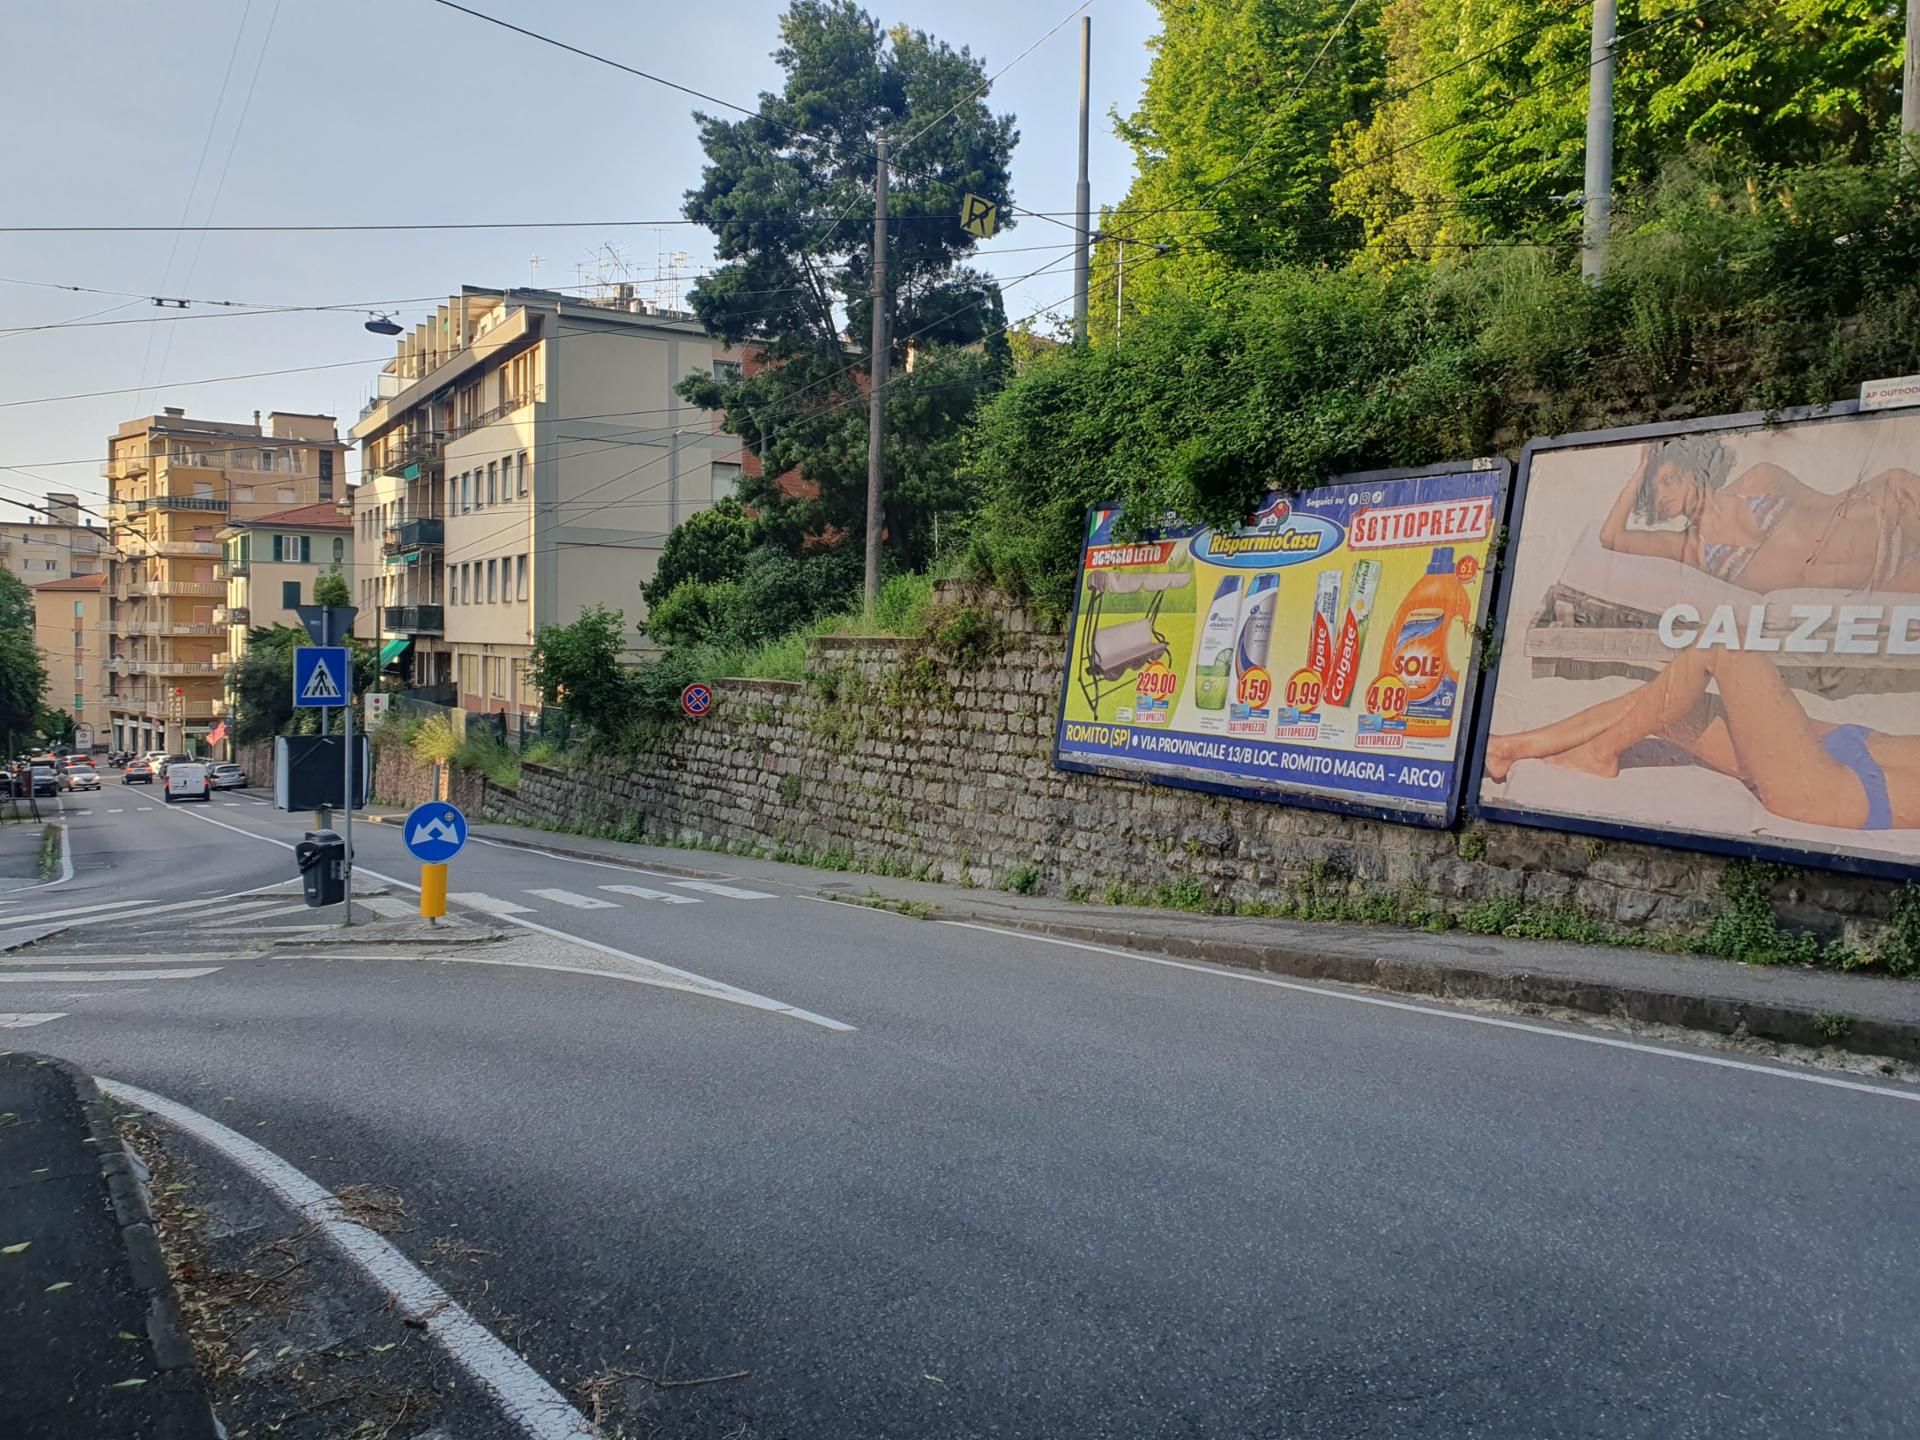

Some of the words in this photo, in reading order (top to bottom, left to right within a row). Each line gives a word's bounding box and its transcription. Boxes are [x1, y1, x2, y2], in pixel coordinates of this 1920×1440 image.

[1880, 386, 1920, 397] OUTDOO
[1306, 497, 1333, 509] Seguici
[1134, 545, 1162, 563] LETTO
[1209, 528, 1321, 556] RisparmioCasa
[1357, 561, 1371, 595] Herbal
[1460, 561, 1473, 575] 61
[1658, 603, 1920, 655] CALZED
[1313, 627, 1326, 673] lgate
[1331, 626, 1357, 701] Colgate
[1394, 655, 1441, 677] SOLE
[1136, 671, 1177, 694] 229,00
[1240, 678, 1269, 702] 1,59
[1286, 681, 1321, 706] 0,99
[1367, 685, 1406, 712] 4,88
[1357, 735, 1400, 746] SOTTOPREZZO
[1066, 724, 1109, 745] ROMITO
[1110, 728, 1131, 750] (SP)
[1141, 734, 1157, 752] VIA
[1158, 738, 1226, 760] PROVINCIALE
[1227, 745, 1252, 765] 13/B
[1253, 750, 1278, 768] LOC.
[1281, 753, 1332, 774] ROMITO
[1334, 759, 1385, 782] MAGRA
